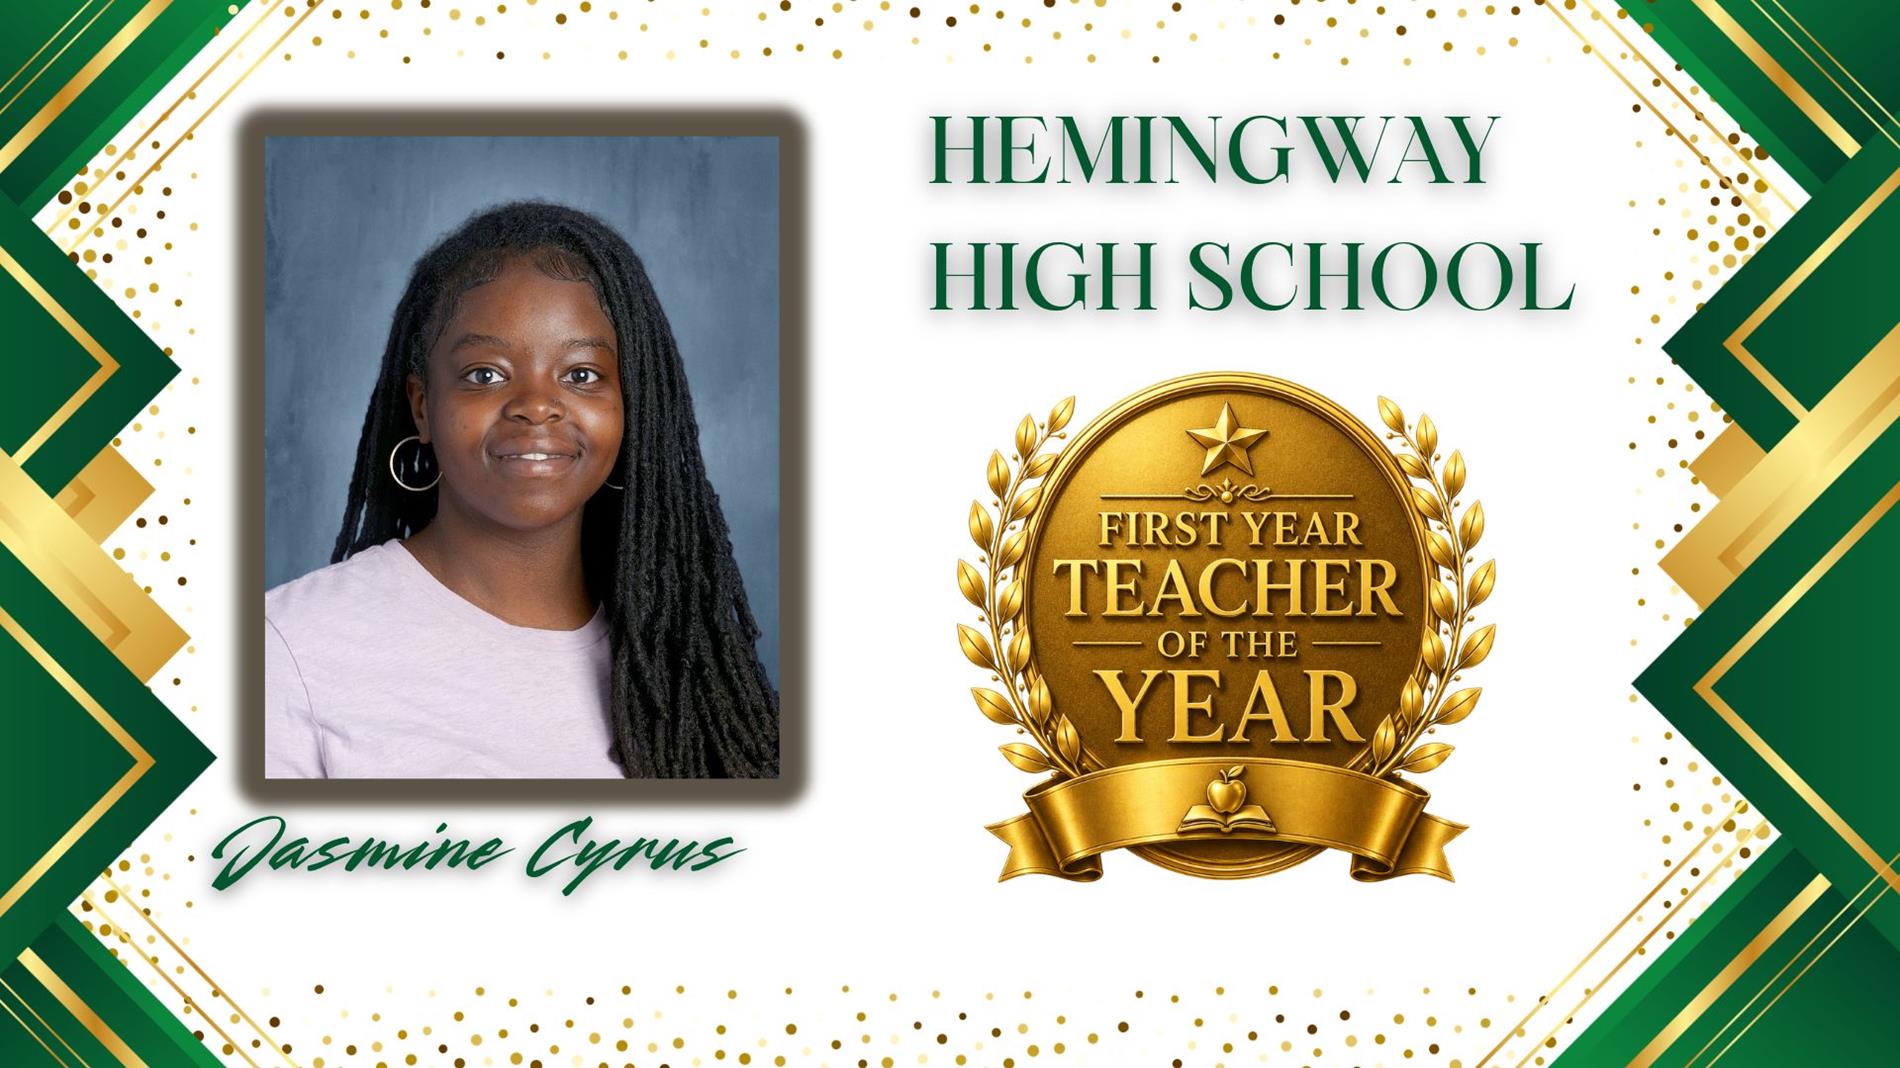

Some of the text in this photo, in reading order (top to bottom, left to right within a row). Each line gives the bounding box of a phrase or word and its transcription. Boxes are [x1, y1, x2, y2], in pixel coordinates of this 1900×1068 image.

[928, 114, 1502, 185] HEMINGWAY
[928, 241, 1576, 311] HIGH SCHOOL
[1098, 511, 1363, 547] FIRST YEAR
[1052, 557, 1404, 618] TEACHER
[1157, 630, 1298, 659] OF THE
[1093, 669, 1366, 744] YEAR
[211, 816, 748, 897] Jasmine Cyrus
